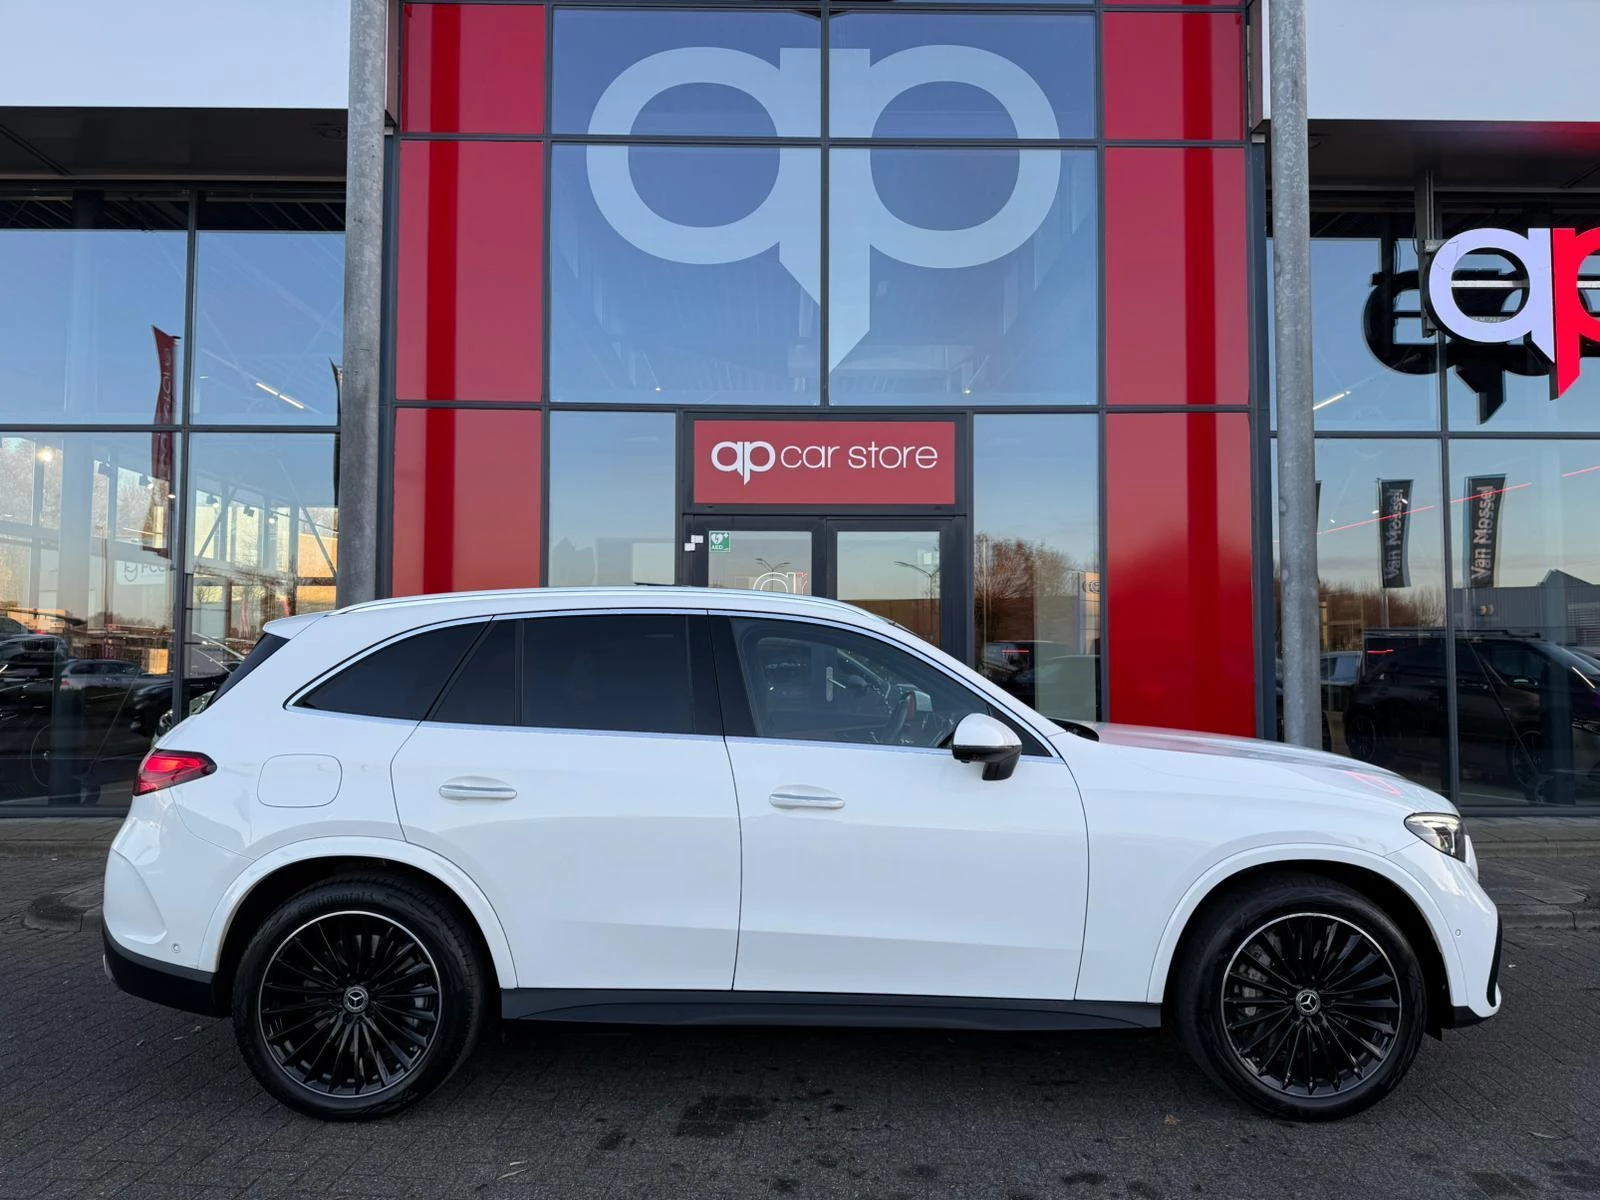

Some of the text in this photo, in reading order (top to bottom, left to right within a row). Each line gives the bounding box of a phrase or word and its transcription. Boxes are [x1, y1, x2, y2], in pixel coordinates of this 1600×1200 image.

[587, 44, 1061, 373] ap
[711, 441, 938, 485] ap car store
[1470, 485, 1497, 580] Van Mossel
